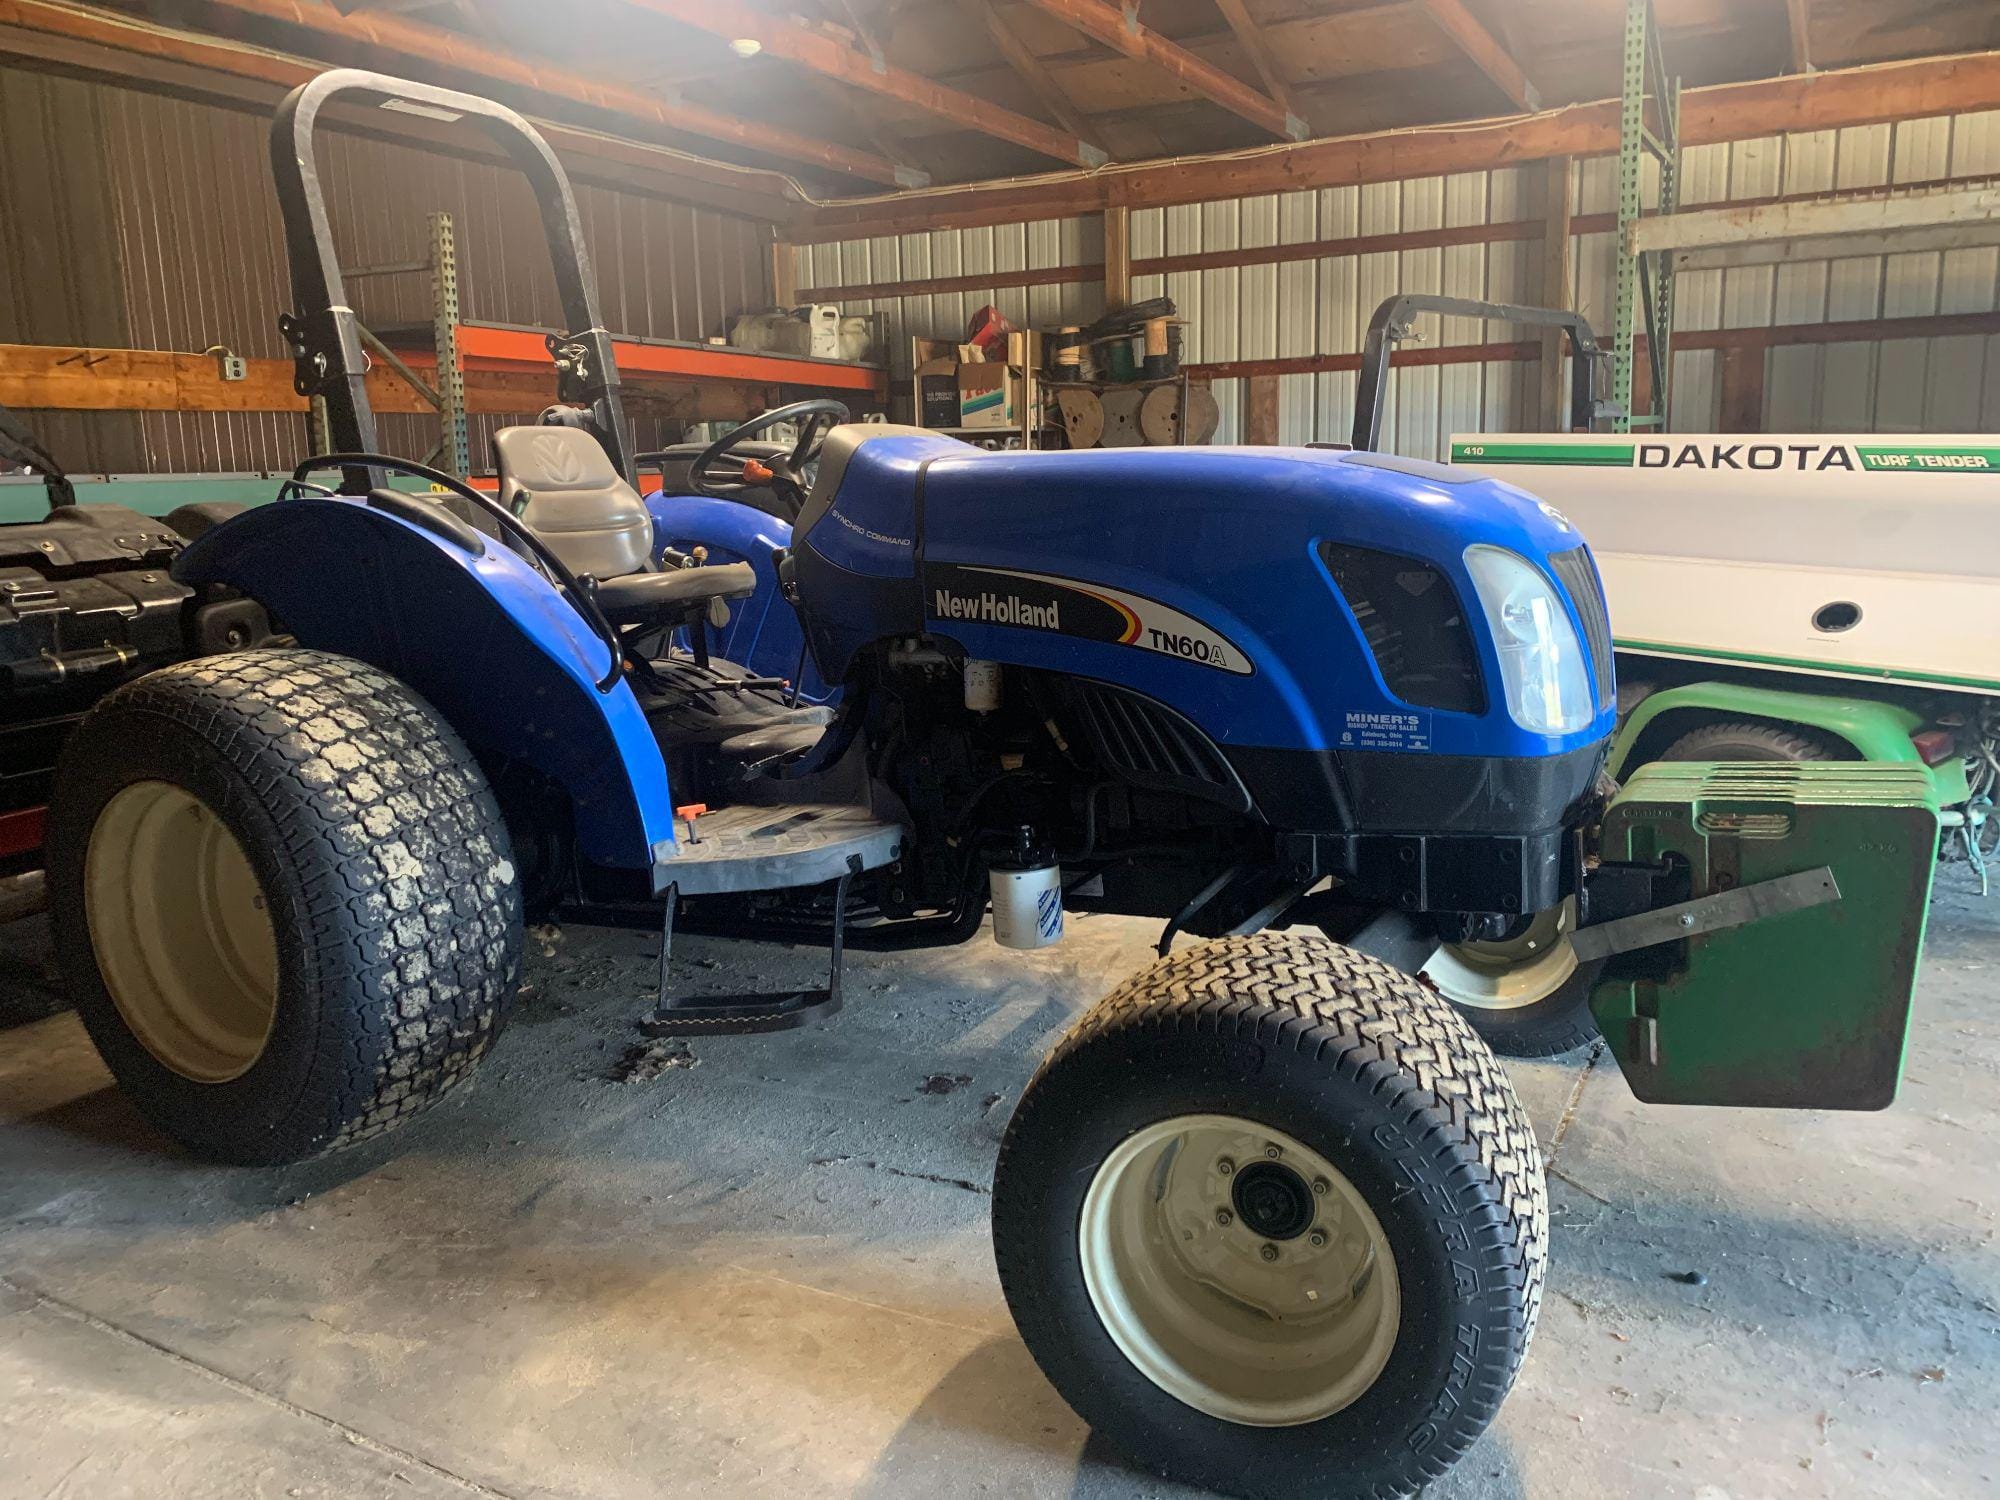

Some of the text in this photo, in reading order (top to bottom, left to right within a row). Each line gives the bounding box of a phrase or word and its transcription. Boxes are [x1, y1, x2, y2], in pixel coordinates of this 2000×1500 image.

[1463, 446, 1484, 456] 410
[1639, 443, 1856, 471] DAKOTA
[1866, 454, 1989, 469] TURF TENDER
[831, 509, 911, 546] SYNCHRO COMMAND
[1148, 628, 1227, 667] TN60A
[1346, 713, 1420, 725] MINER'S
[1370, 723, 1397, 731] TRACTOR
[1399, 724, 1418, 732] SALES
[1373, 1122, 1481, 1456] ULTRA TRAC
